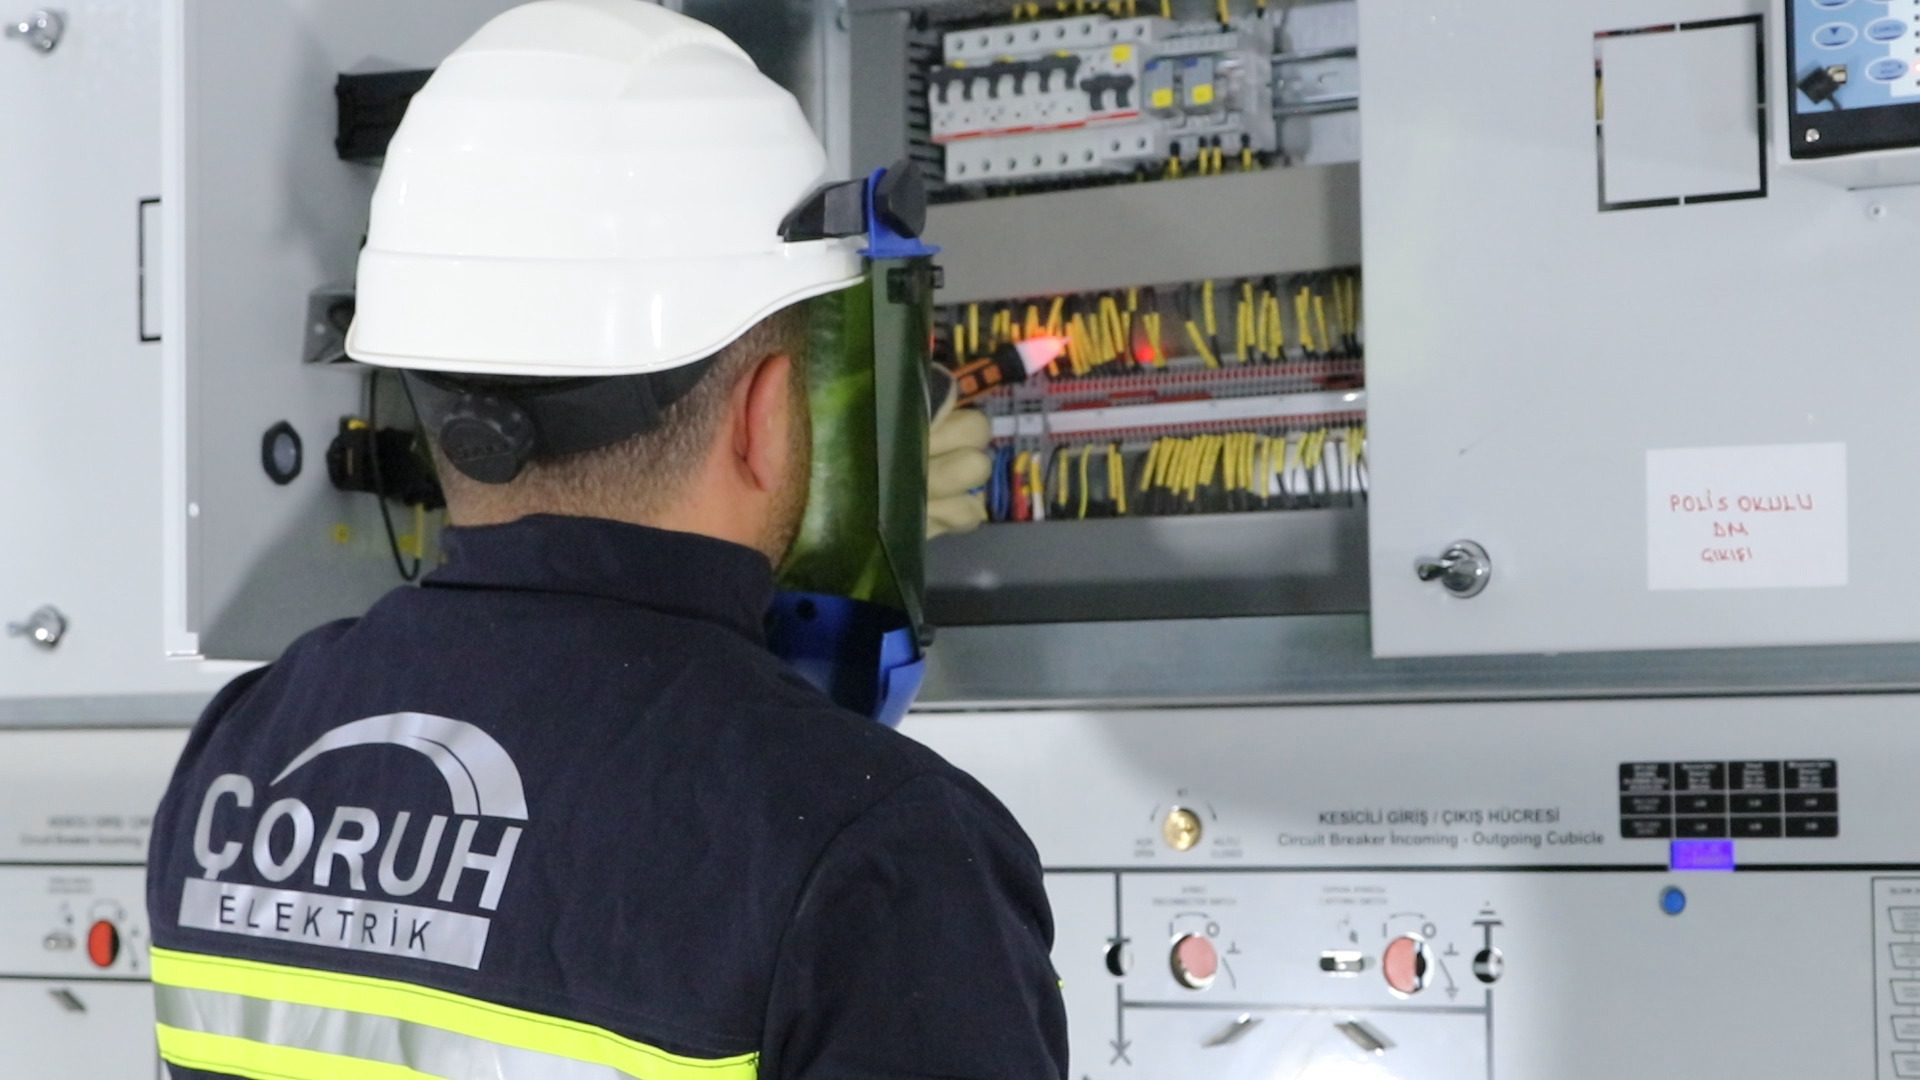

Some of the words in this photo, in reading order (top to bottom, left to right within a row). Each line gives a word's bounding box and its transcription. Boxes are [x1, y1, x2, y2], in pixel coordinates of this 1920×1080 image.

[1737, 494, 1813, 512] OKULU
[1388, 807, 1429, 827] GİRİŞ
[1442, 808, 1484, 827] ÇIKIŞ
[1488, 805, 1560, 823] HÜCRESİ
[193, 774, 523, 910] ÇORUH
[1278, 832, 1325, 846] Circuit
[1330, 832, 1385, 847] Breaker
[1473, 831, 1542, 848] Outgoing
[1546, 831, 1605, 847] Cubicle
[218, 894, 432, 953] ELEKTRİK
